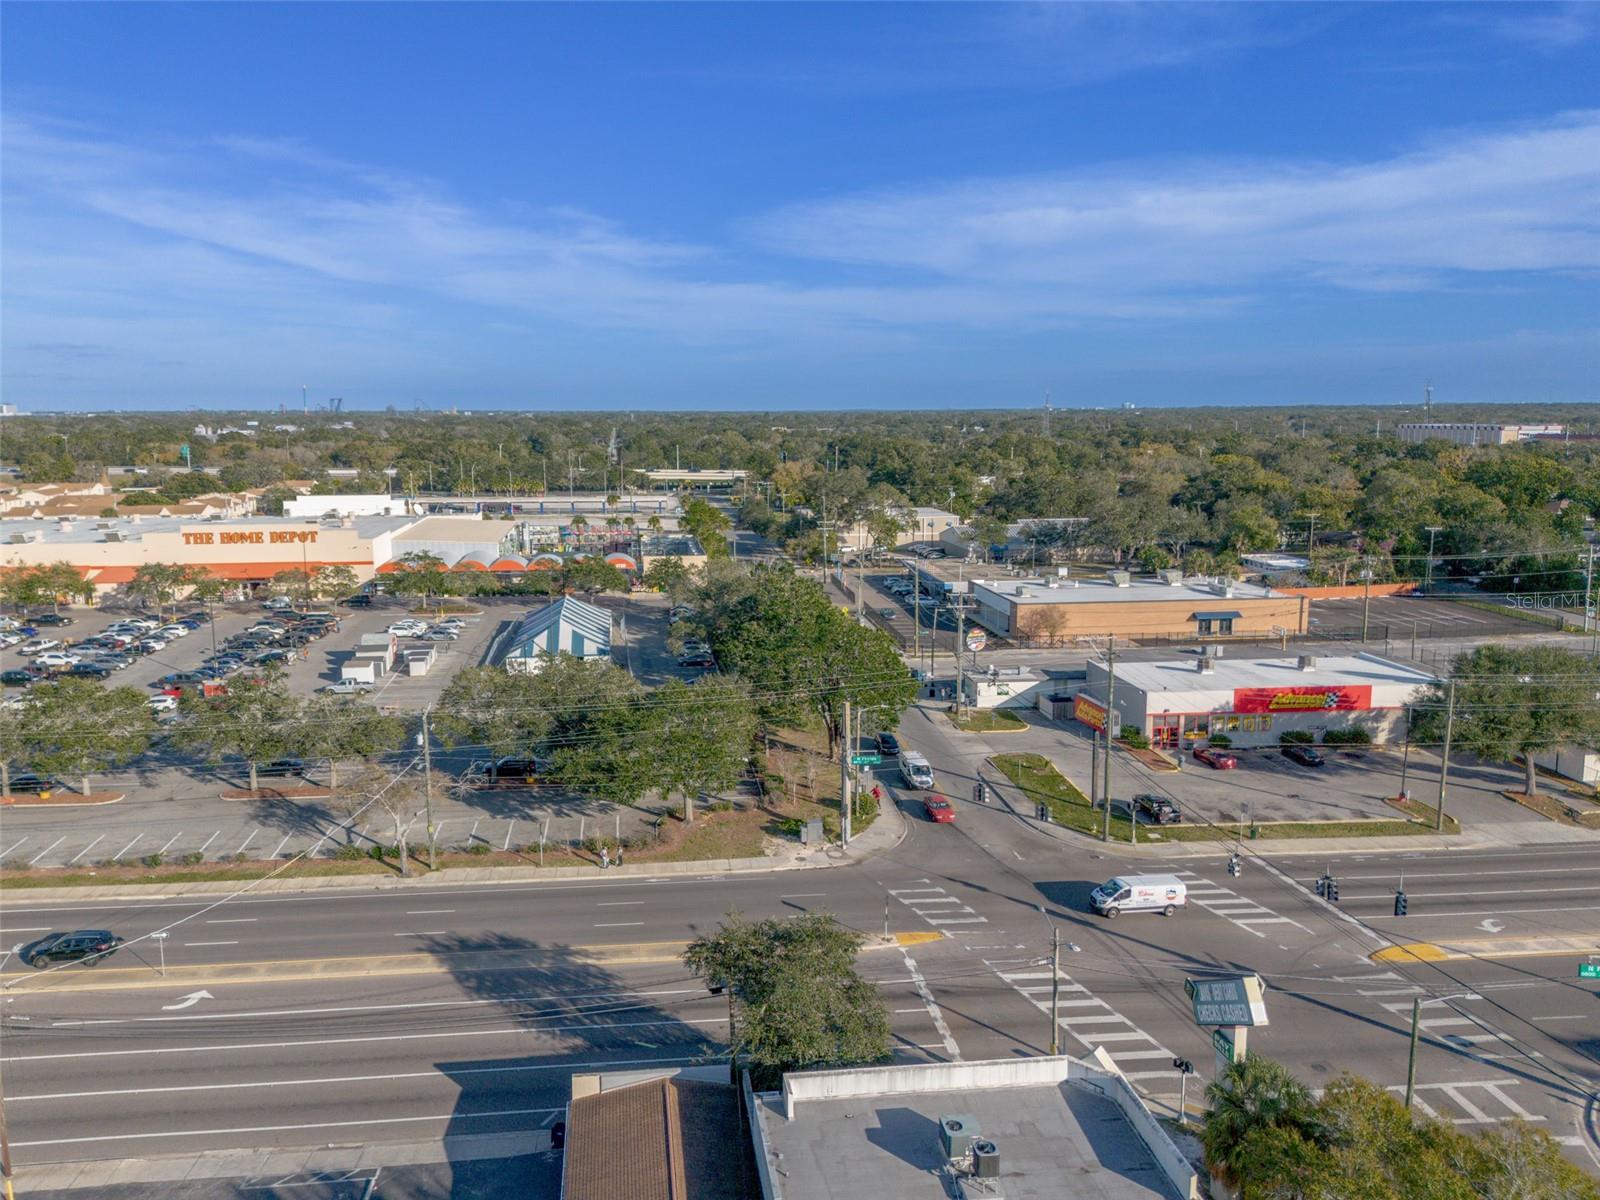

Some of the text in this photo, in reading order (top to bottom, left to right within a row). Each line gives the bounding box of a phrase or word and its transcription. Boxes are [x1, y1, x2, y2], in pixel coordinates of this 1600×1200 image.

[182, 530, 318, 545] THE HOME DEPOT
[1197, 1004, 1249, 1022] CHECKS CASHED
